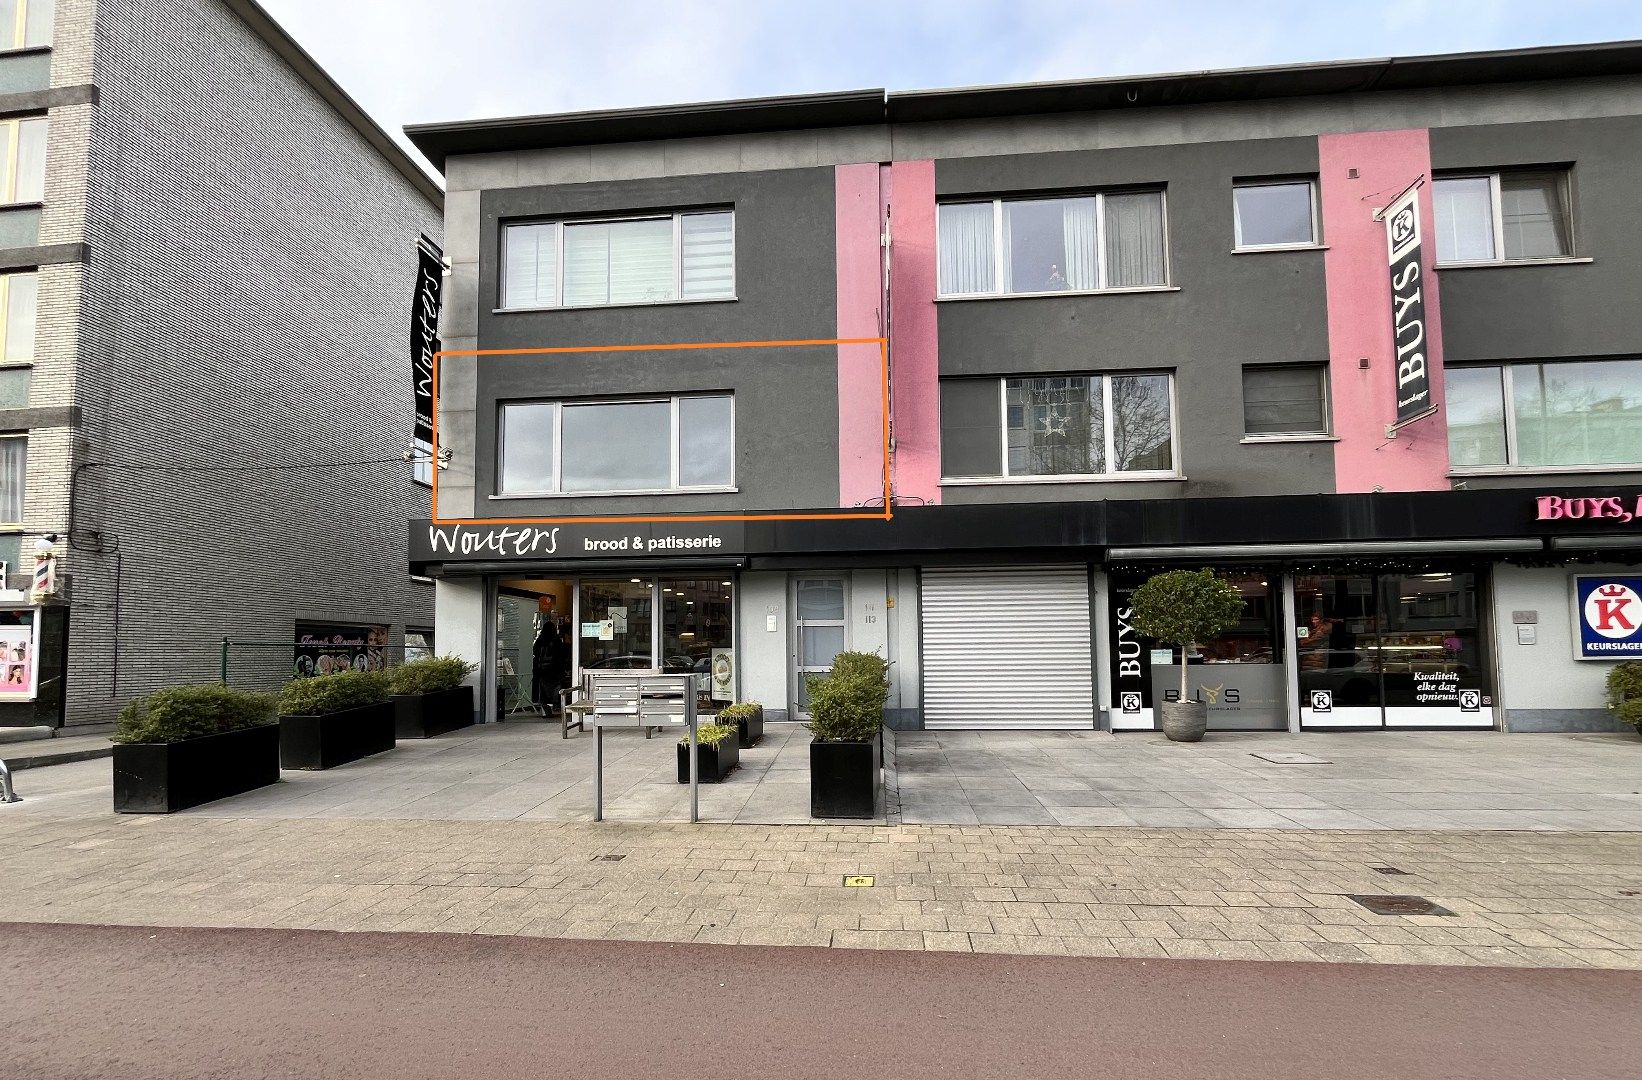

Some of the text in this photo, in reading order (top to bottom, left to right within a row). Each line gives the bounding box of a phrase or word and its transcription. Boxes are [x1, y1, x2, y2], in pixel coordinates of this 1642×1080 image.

[415, 268, 438, 396] Wouters
[1393, 261, 1425, 389] BUYS
[1535, 495, 1632, 524] BUYS,
[429, 525, 722, 555] Wouters brood & patisserie
[1594, 599, 1635, 630] K
[1117, 607, 1141, 678] BUYS
[1414, 671, 1460, 681] Kwaliteit,
[1417, 682, 1456, 692] elke dag
[1416, 692, 1459, 702] opnieuw.
